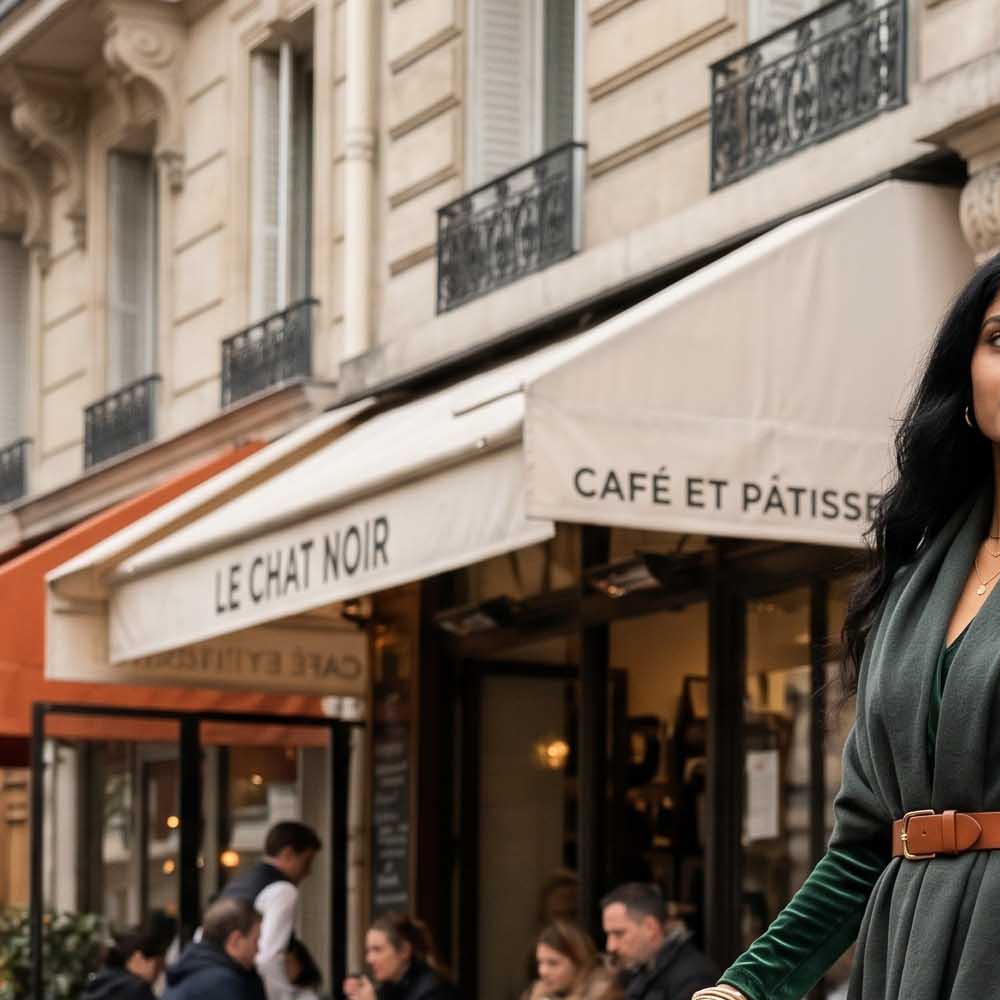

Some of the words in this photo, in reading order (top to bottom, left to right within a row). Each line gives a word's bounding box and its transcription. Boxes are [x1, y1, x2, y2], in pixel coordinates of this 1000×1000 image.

[573, 466, 672, 506] CAFÉ
[686, 477, 729, 510] ET
[215, 563, 242, 615] LE
[249, 538, 315, 605] CHAT
[323, 515, 390, 584] NOIR
